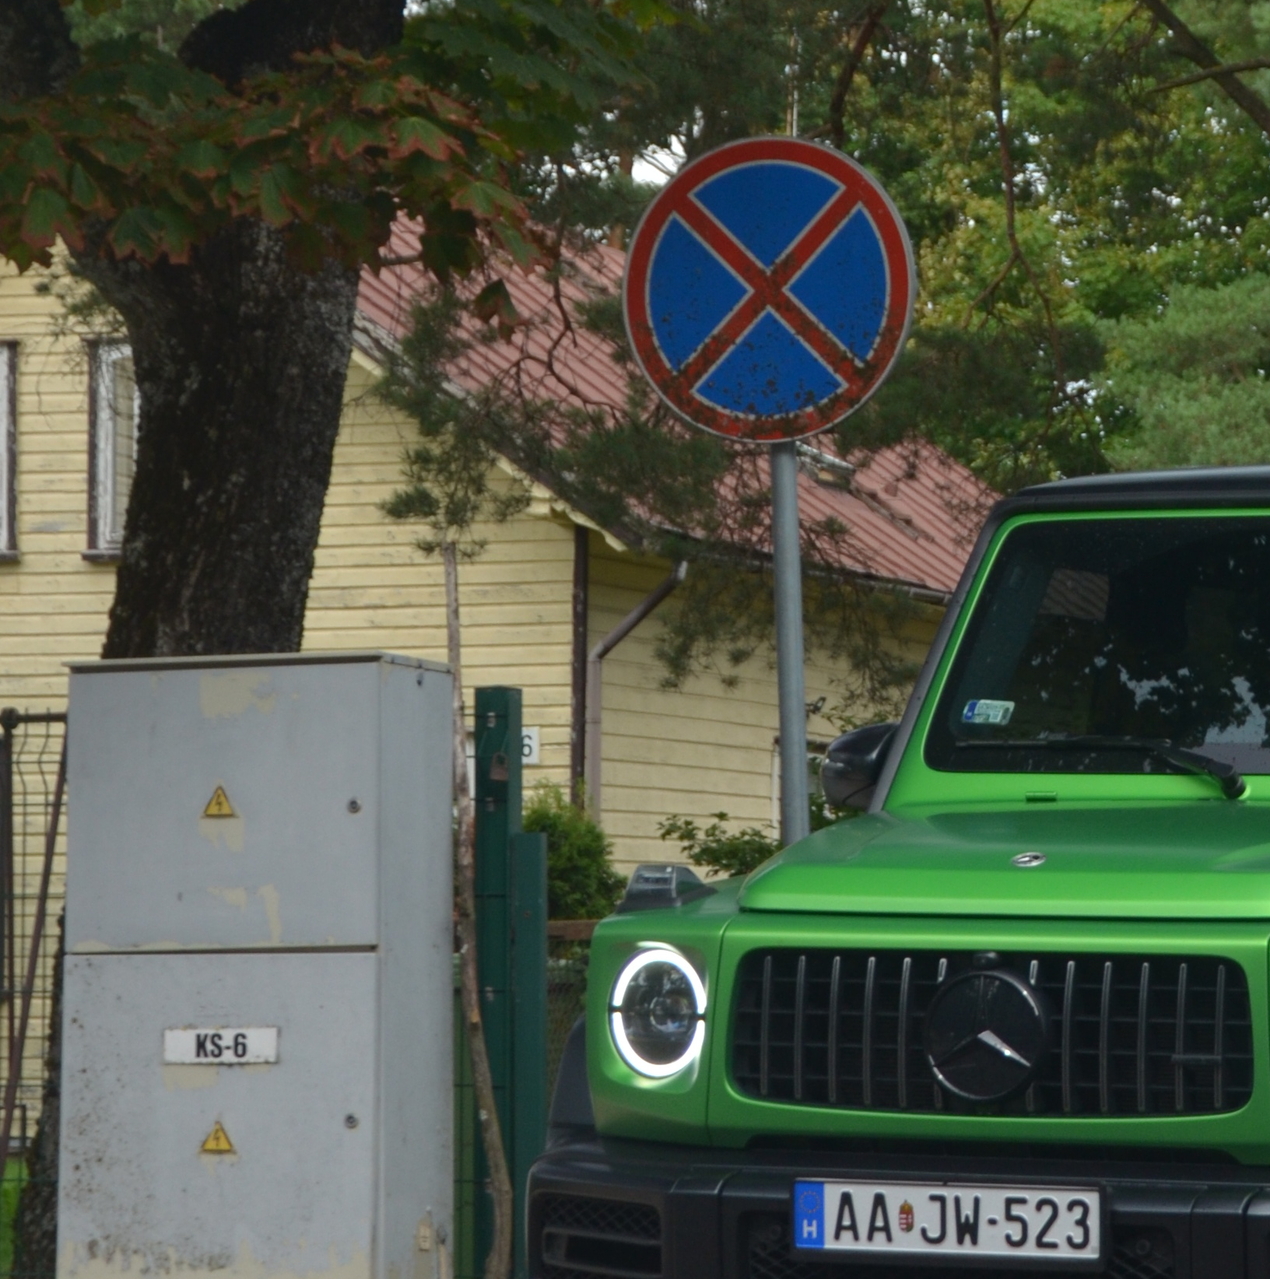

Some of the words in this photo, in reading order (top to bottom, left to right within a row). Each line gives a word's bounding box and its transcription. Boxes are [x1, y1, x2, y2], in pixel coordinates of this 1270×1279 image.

[195, 1032, 247, 1058] KS-6
[803, 1219, 818, 1239] H
[834, 1189, 893, 1243] AA
[920, 1193, 1091, 1250] JW-523
